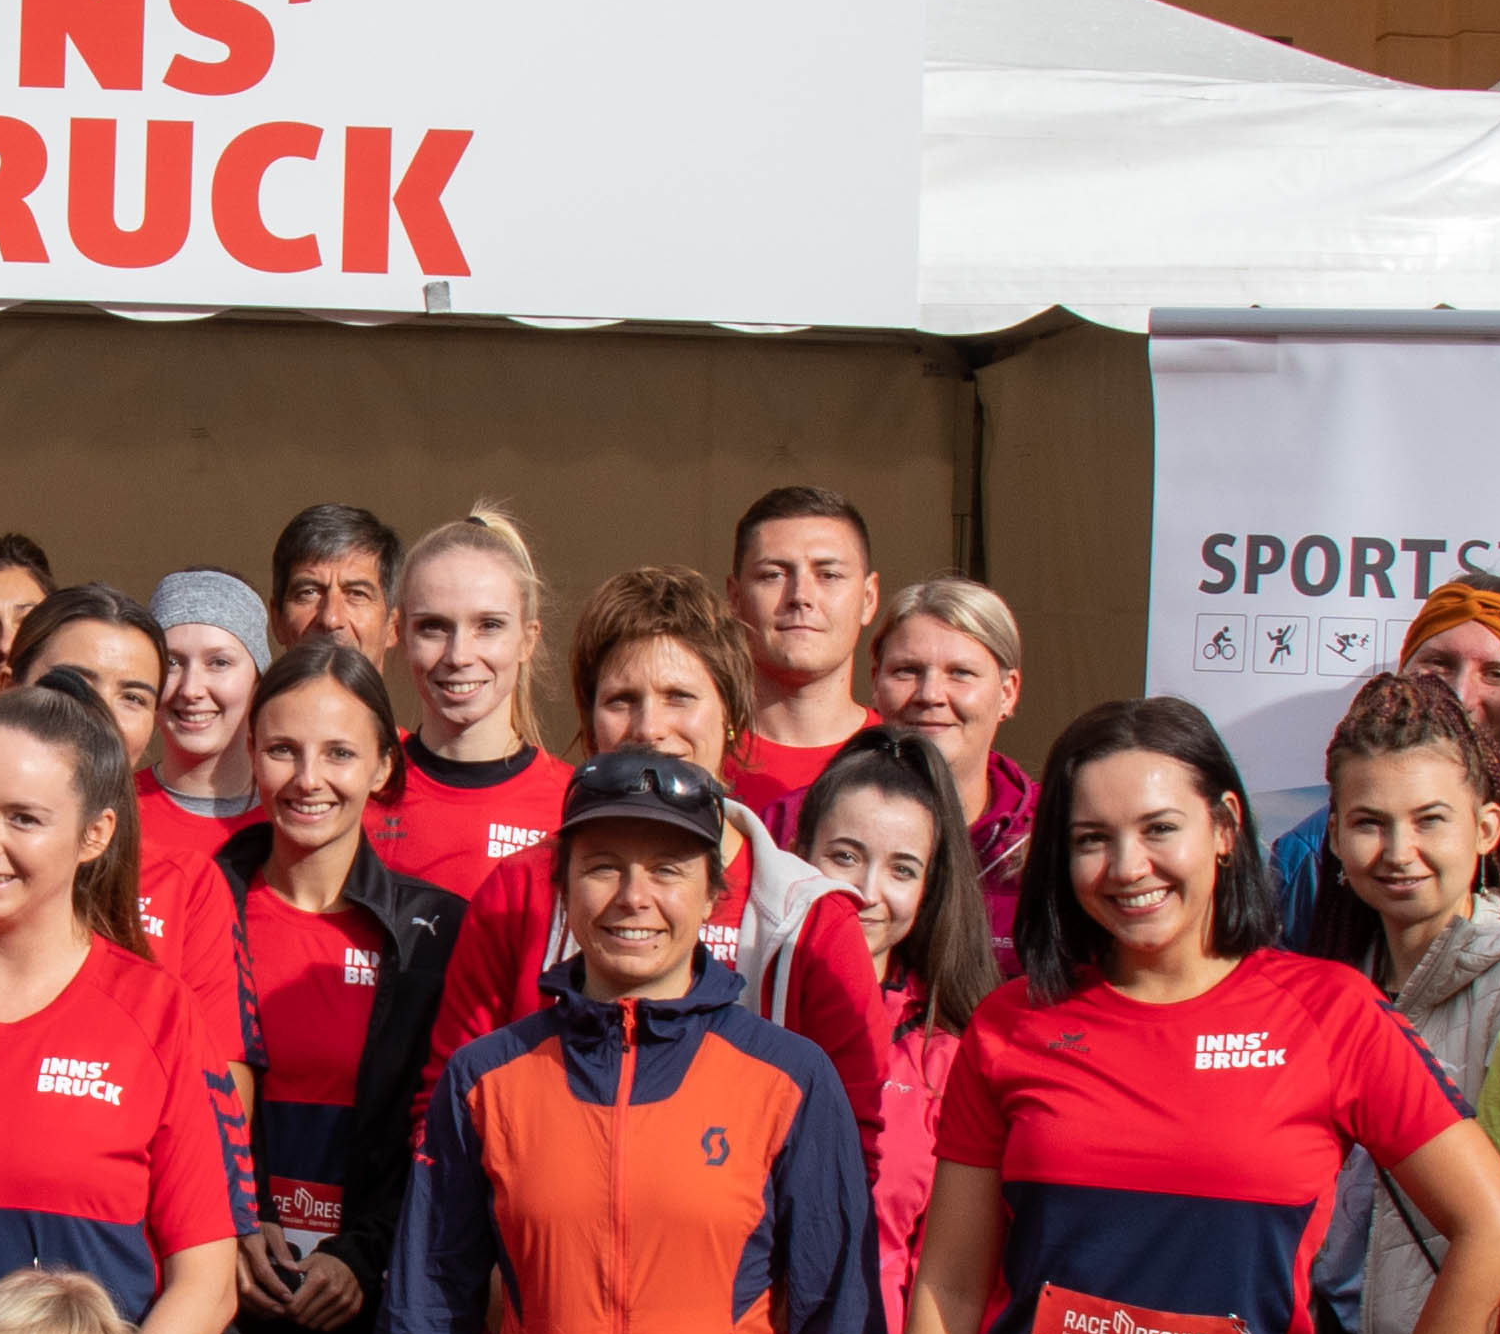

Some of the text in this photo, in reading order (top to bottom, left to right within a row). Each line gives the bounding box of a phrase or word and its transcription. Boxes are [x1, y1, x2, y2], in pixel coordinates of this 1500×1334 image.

[1197, 1031, 1270, 1053] INNS'
[40, 1057, 110, 1080] INNS'
[1194, 1048, 1287, 1070] BRUCK
[37, 1074, 124, 1106] BRUCK
